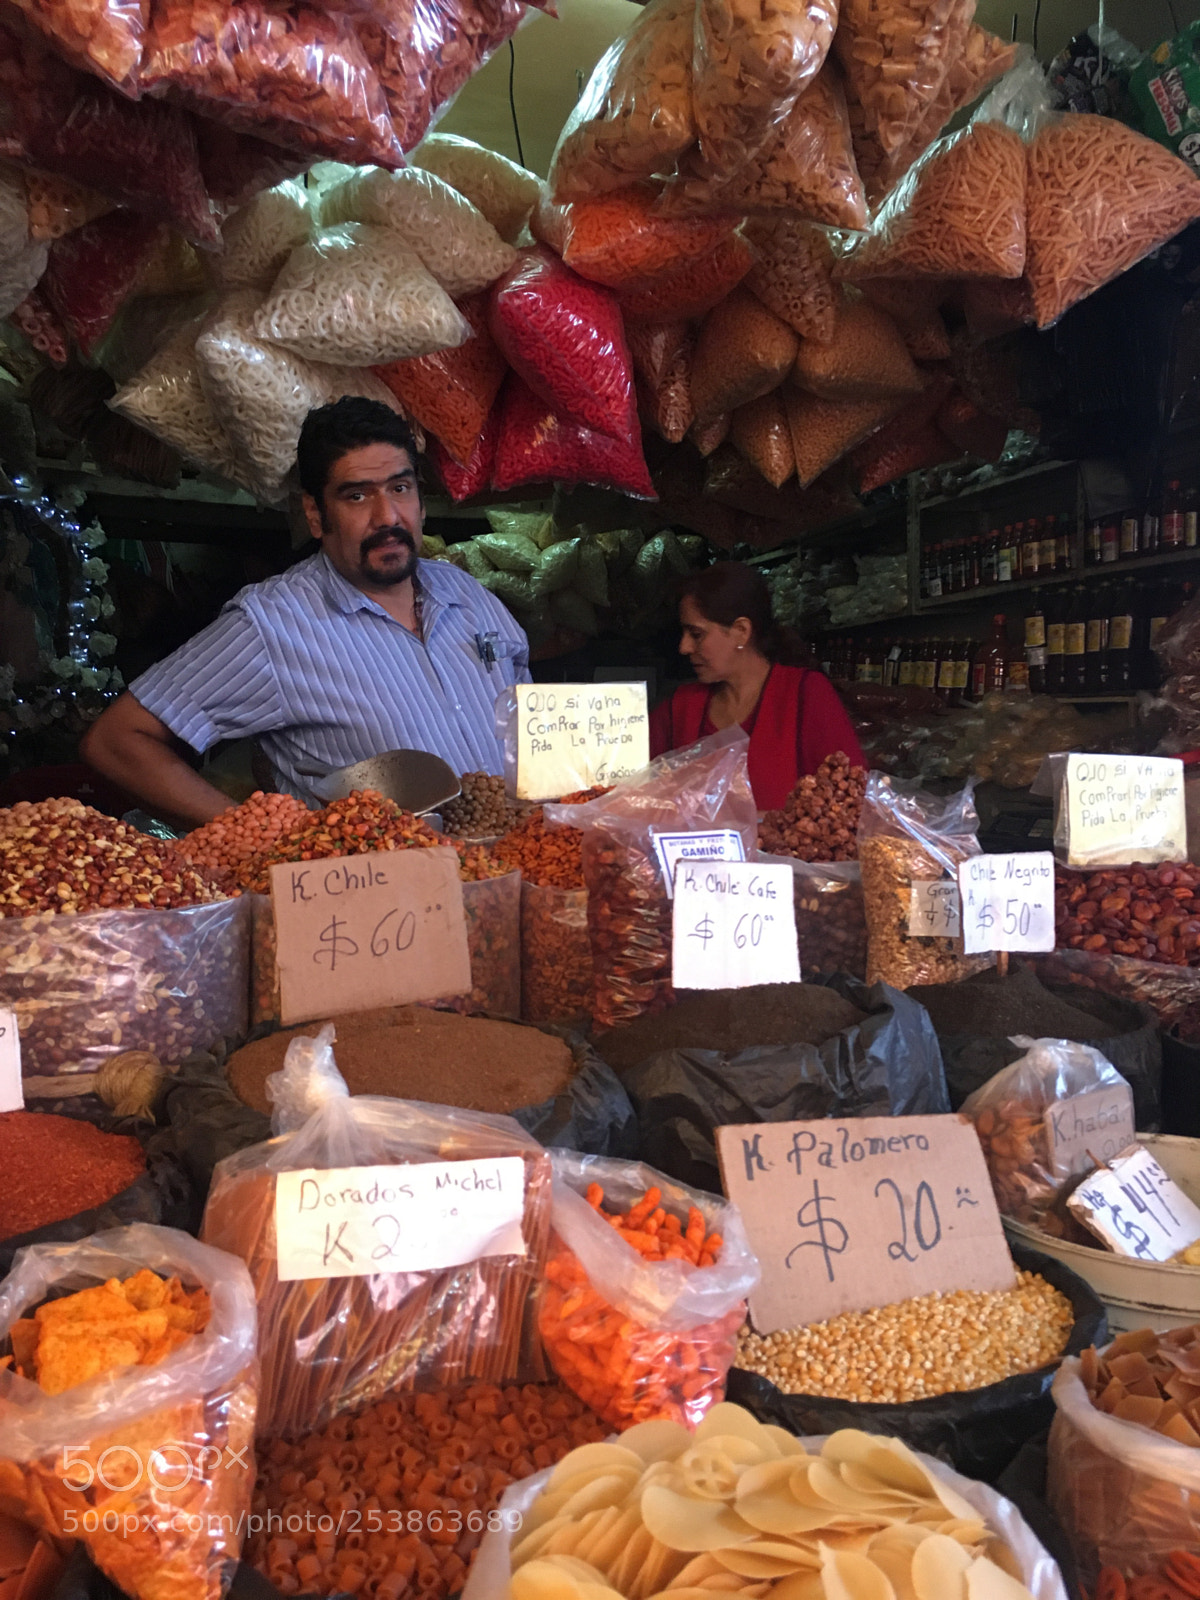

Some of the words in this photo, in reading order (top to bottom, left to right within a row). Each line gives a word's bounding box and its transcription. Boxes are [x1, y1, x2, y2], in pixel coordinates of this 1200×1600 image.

[681, 845, 725, 857] GAMIÑO
[324, 862, 389, 896] Chile
[786, 1127, 930, 1176] Palomero
[298, 1178, 415, 1213] Dorados
